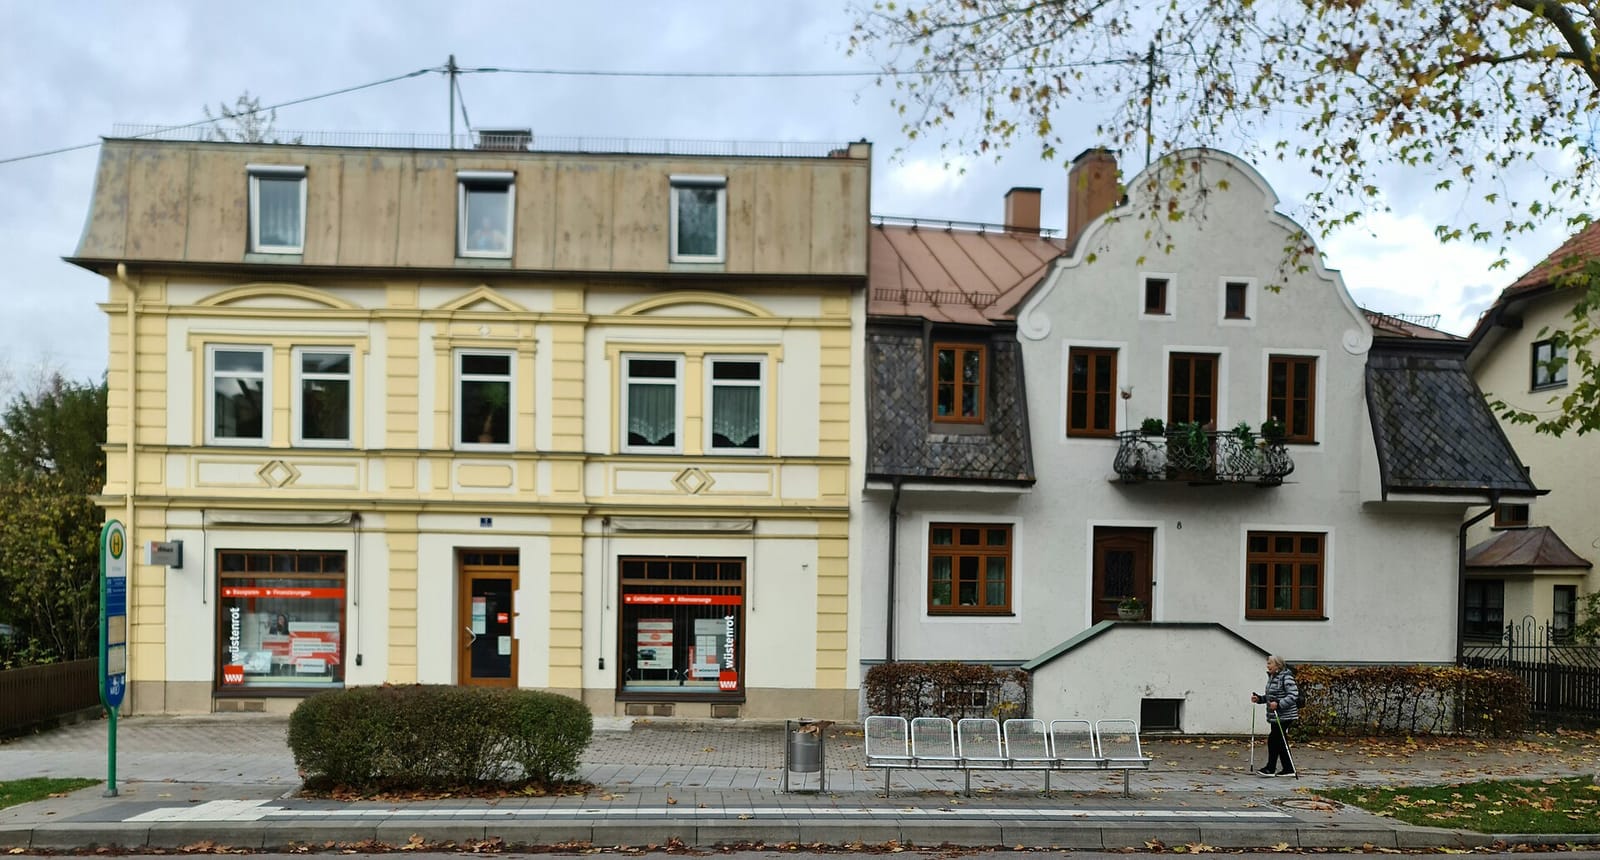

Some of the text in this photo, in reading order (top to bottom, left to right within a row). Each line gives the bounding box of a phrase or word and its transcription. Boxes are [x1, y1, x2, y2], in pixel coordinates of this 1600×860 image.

[1176, 520, 1183, 530] 8
[229, 607, 241, 662] wüstenrot
[723, 615, 735, 669] wüstenrot
